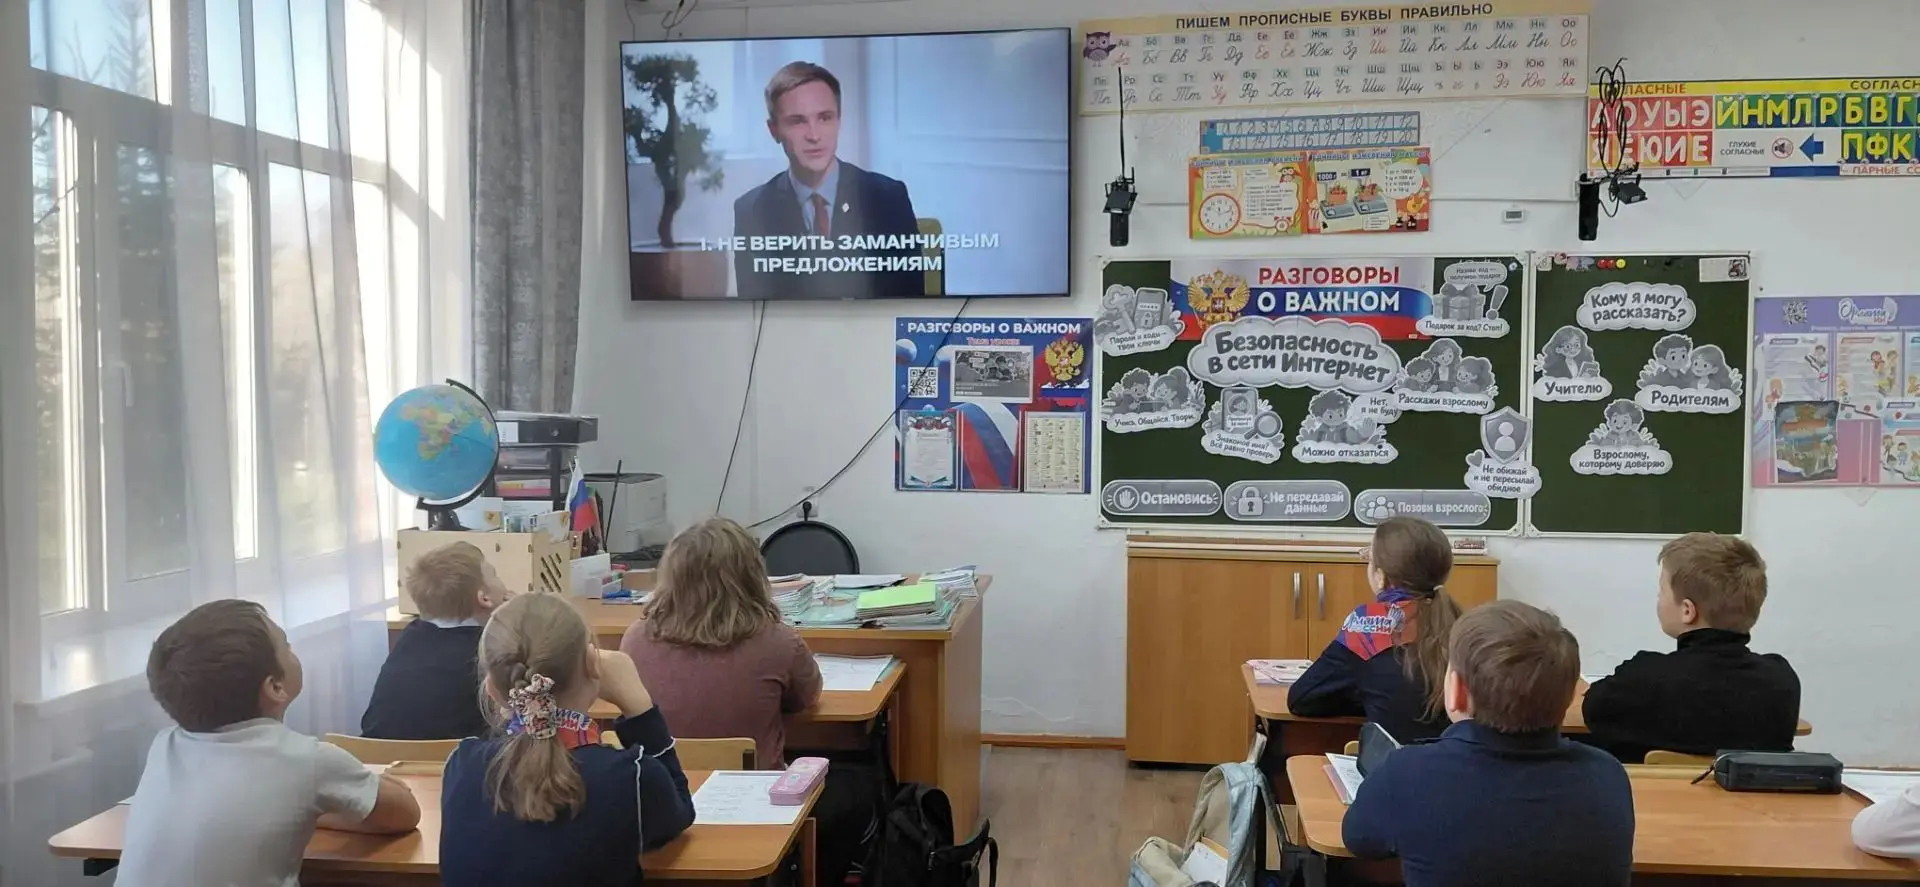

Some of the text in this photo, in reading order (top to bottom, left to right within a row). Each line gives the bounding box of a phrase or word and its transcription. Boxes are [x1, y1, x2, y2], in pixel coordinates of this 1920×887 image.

[1176, 3, 1493, 29] ПИШЕМ ПРОПИСНЫЕ БУКВЫ ПРАВИЛЬНО
[1562, 19, 1576, 28] Оо
[1619, 84, 1686, 95] ЛАСНЫЕ
[1853, 166, 1900, 174] ПАРНЫЕ
[718, 236, 746, 251] НЕ
[751, 235, 835, 252] ВЕРИТЬ
[838, 232, 1000, 250] ЗАМАНЧИВЫМ
[753, 256, 942, 275] ПРЕДЛОЖЕНИЯМ
[1259, 266, 1399, 285] РАЗГОВОРЫ
[1257, 290, 1400, 312] О ВАЖНОМ
[1591, 292, 1682, 308] Кому я могу
[1592, 306, 1687, 324] рассказать?
[907, 322, 1081, 334] РАЗГОВОРЫ О ВАЖНОМ
[1426, 320, 1455, 332] Подарок
[1466, 323, 1482, 332] код?
[1483, 322, 1503, 332] Стоп!
[1215, 331, 1379, 361] Безопасность
[1208, 352, 1390, 382] в сети Интернет
[1545, 381, 1603, 395] Учителю
[1399, 393, 1489, 409] Расскажи взрослому
[1651, 390, 1729, 407] Родителям
[1380, 406, 1399, 416] буду
[1210, 440, 1223, 449] Всё
[1224, 445, 1246, 454] равно
[1216, 433, 1269, 451] Знакомое имя?
[1302, 447, 1389, 458] Можно отказаться
[1593, 449, 1650, 460] Взрослому,
[1482, 464, 1527, 475] Не обижай
[1579, 460, 1665, 470] которому доверяю
[1493, 475, 1535, 485] пересылай
[1487, 484, 1521, 493] обидное
[1141, 491, 1213, 505] Остановись
[1270, 491, 1344, 505] Не передавай
[1285, 503, 1328, 514] данные
[1397, 501, 1434, 511] Позови
